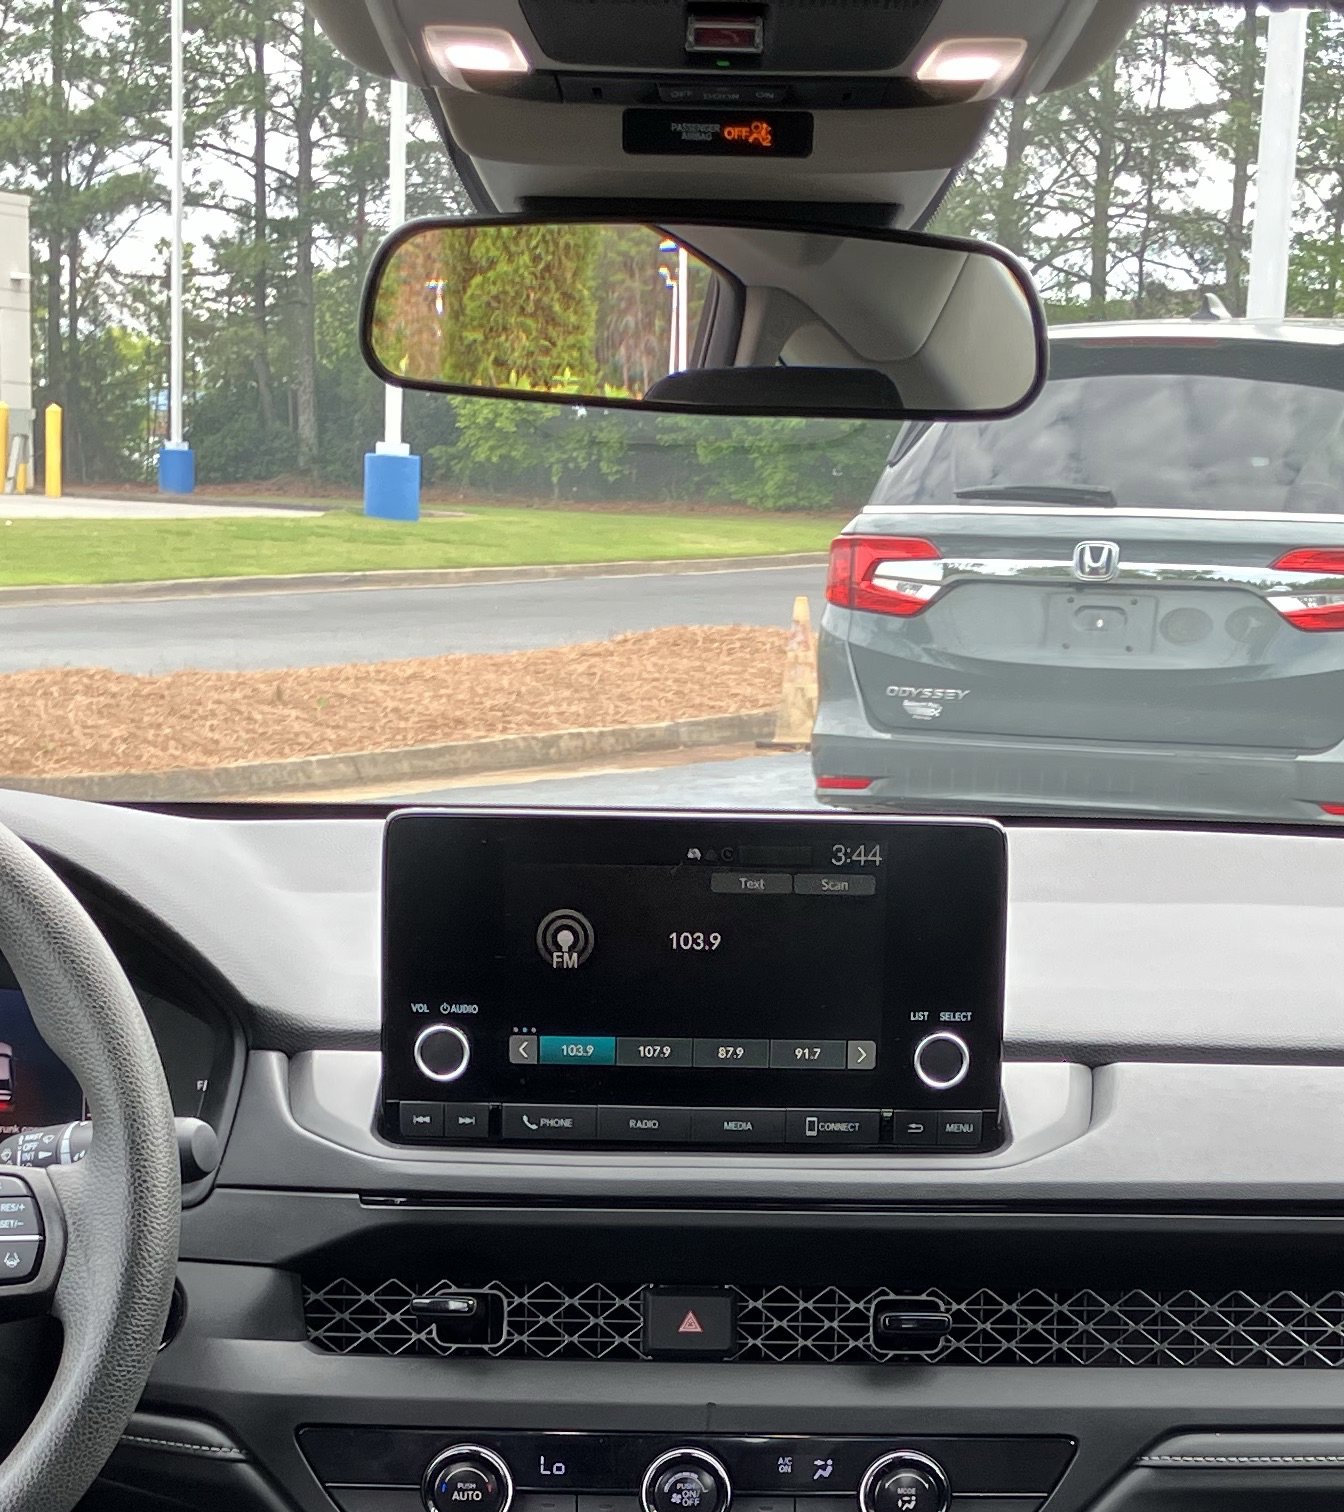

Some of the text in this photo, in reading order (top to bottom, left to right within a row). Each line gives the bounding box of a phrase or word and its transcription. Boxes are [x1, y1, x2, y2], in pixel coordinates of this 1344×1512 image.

[671, 123, 721, 133] PASSENGER
[723, 126, 750, 140] OFF
[885, 685, 971, 700] ODYSSEY
[831, 844, 883, 866] 3:44
[738, 877, 765, 890] Text
[821, 878, 849, 891] Scan
[668, 932, 722, 950] 103.9
[552, 952, 578, 969] FM
[410, 1003, 479, 1014] VOL AUDIO
[910, 1011, 972, 1022] LIST SELECT
[561, 1044, 594, 1056] 103.9
[638, 1045, 671, 1058] 107.9
[718, 1047, 744, 1059] 87.9
[795, 1047, 821, 1060] 91.7
[540, 1118, 573, 1128] PHONE
[629, 1119, 659, 1129] RADIO
[723, 1121, 753, 1131] MEDIA
[818, 1122, 859, 1132] CONNECT
[945, 1123, 974, 1133] MENU
[22, 1142, 40, 1151] OFF
[0, 1203, 26, 1212] RES/+
[777, 1456, 793, 1465] A/C
[778, 1465, 792, 1473] ON
[452, 1491, 482, 1501] AUTO
[897, 1487, 916, 1495] MODE
[681, 1498, 700, 1507] OFF
